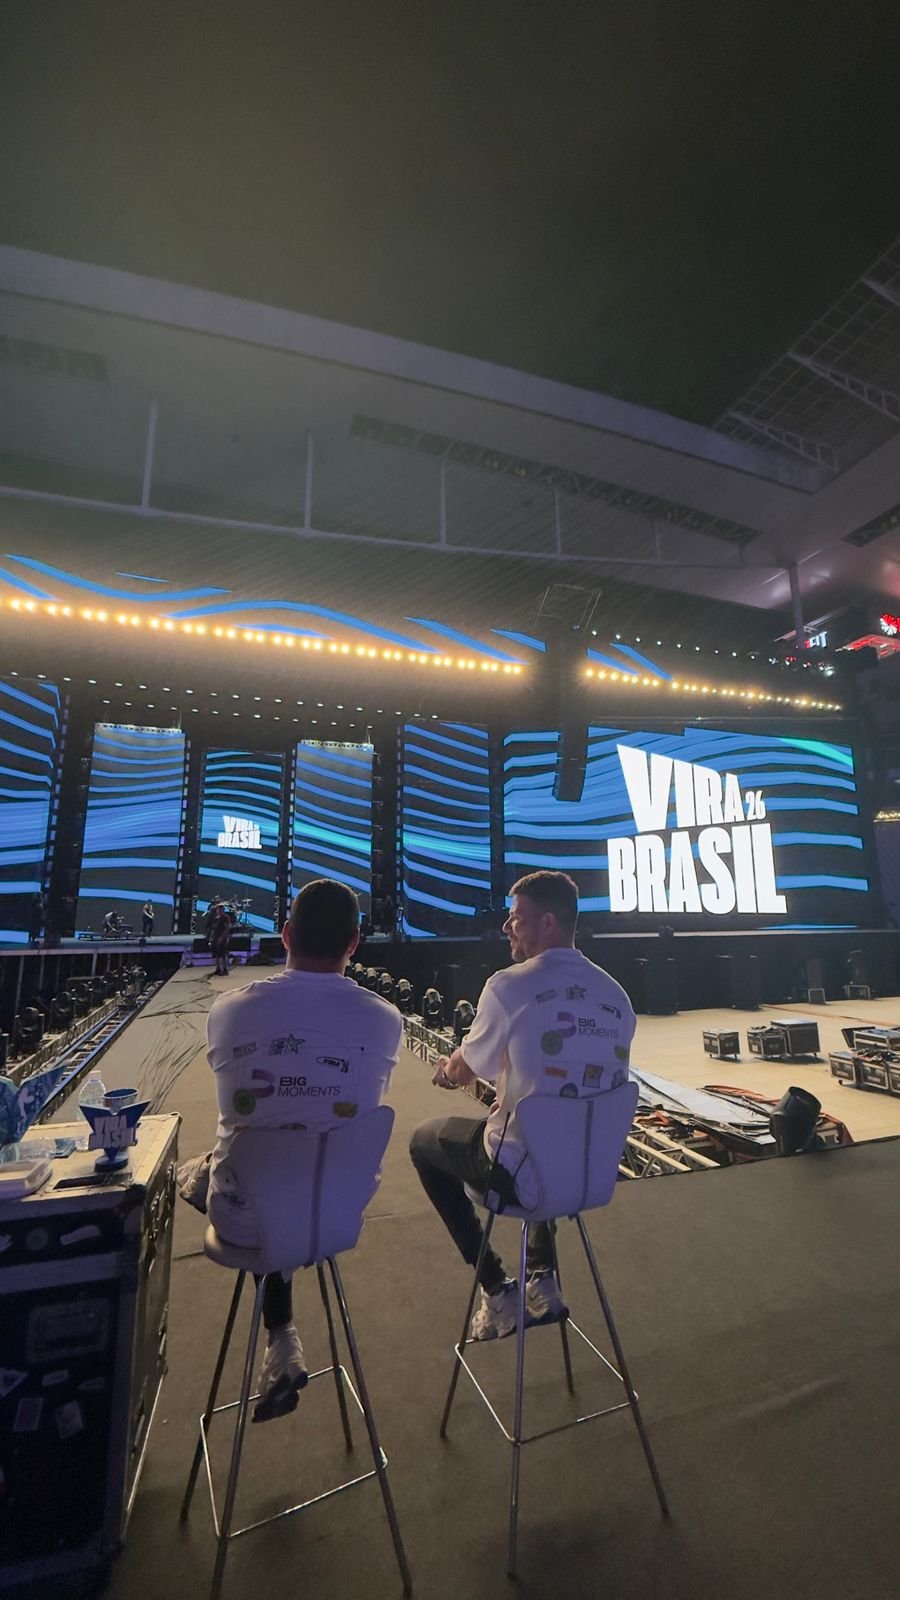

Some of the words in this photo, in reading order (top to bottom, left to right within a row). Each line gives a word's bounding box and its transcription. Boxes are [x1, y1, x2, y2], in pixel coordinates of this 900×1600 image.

[616, 744, 745, 833] VIRA
[745, 791, 766, 820] 26
[218, 830, 262, 848] BRASIL
[607, 822, 788, 915] BRASIL
[579, 1018, 596, 1027] BIG
[579, 1028, 618, 1038] MOMENTS
[280, 1077, 306, 1086] BIG
[278, 1086, 341, 1097] MOMENTS
